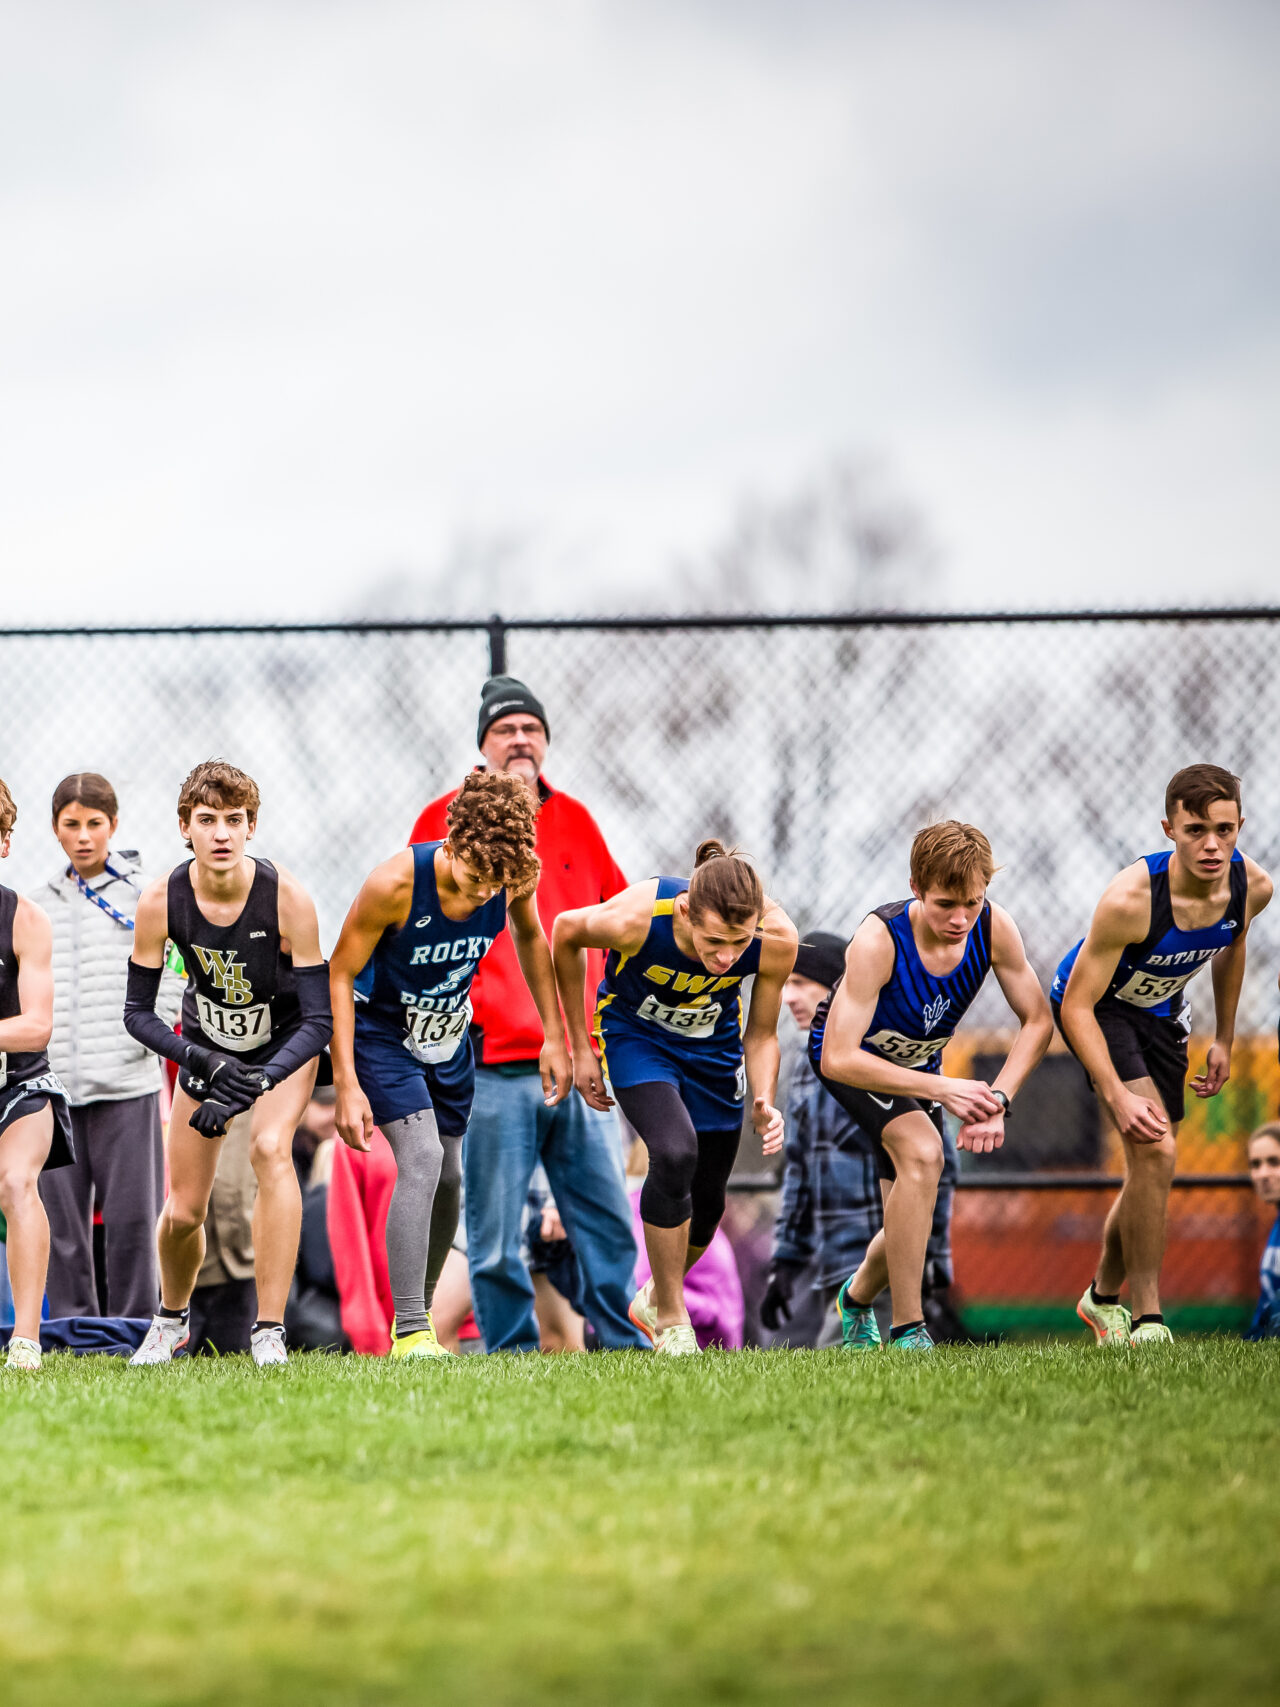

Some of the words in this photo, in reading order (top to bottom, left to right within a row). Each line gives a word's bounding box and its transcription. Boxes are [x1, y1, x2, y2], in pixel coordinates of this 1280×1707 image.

[202, 1001, 265, 1038] 1137
[407, 1012, 467, 1044] 1134
[647, 1002, 718, 1028] 1135
[879, 1036, 942, 1060] 535
